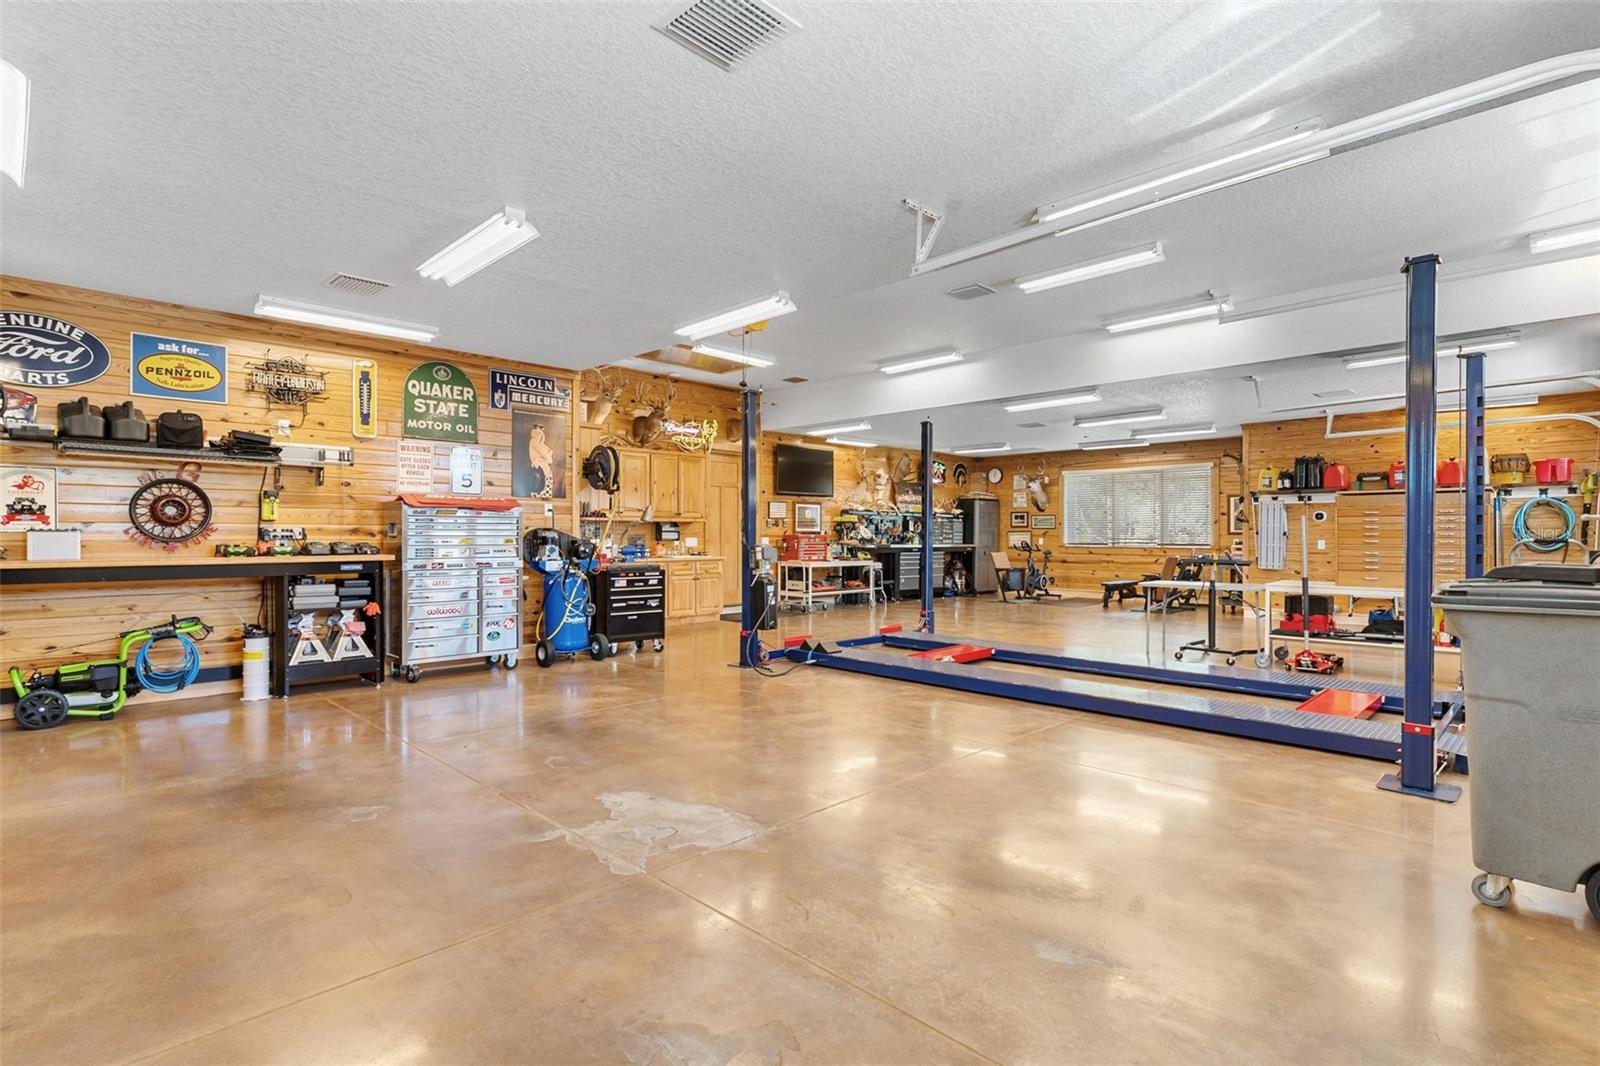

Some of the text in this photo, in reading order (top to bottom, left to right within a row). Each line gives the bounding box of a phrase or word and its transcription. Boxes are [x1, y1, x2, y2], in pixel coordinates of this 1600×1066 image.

[0, 313, 86, 341] ENUINE
[0, 331, 86, 365] Ford
[158, 343, 180, 353] ask
[145, 366, 215, 379] PENNZOIL
[496, 373, 553, 391] LINCOLN
[407, 379, 475, 402] QUAKER
[511, 392, 564, 407] MERCURY
[413, 398, 470, 418] STATE
[407, 418, 475, 434] MOTOR OIL
[400, 444, 431, 453] WARNING
[461, 473, 473, 488] 5
